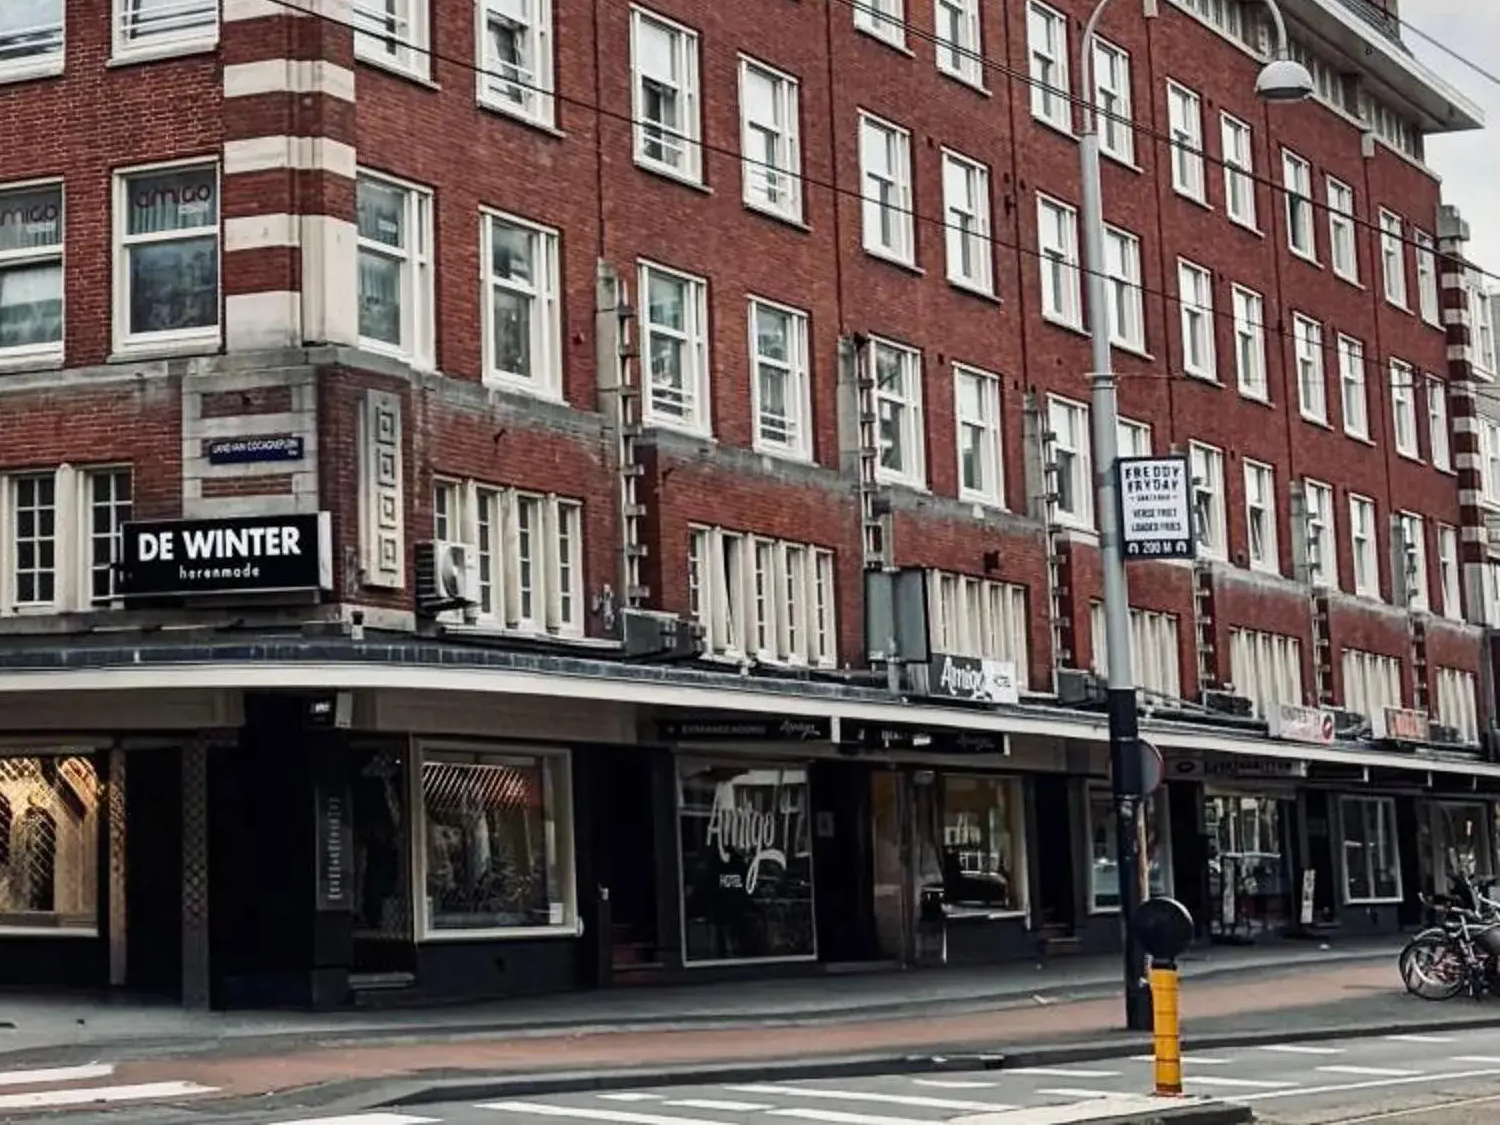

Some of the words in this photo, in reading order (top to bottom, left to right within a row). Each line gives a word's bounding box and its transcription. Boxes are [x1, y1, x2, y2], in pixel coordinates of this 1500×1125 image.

[1125, 466, 1180, 479] FREDDY
[1128, 480, 1179, 493] FRYDAY
[138, 532, 174, 562] DE
[181, 526, 302, 560] WINTER
[706, 782, 788, 894] Amigo
